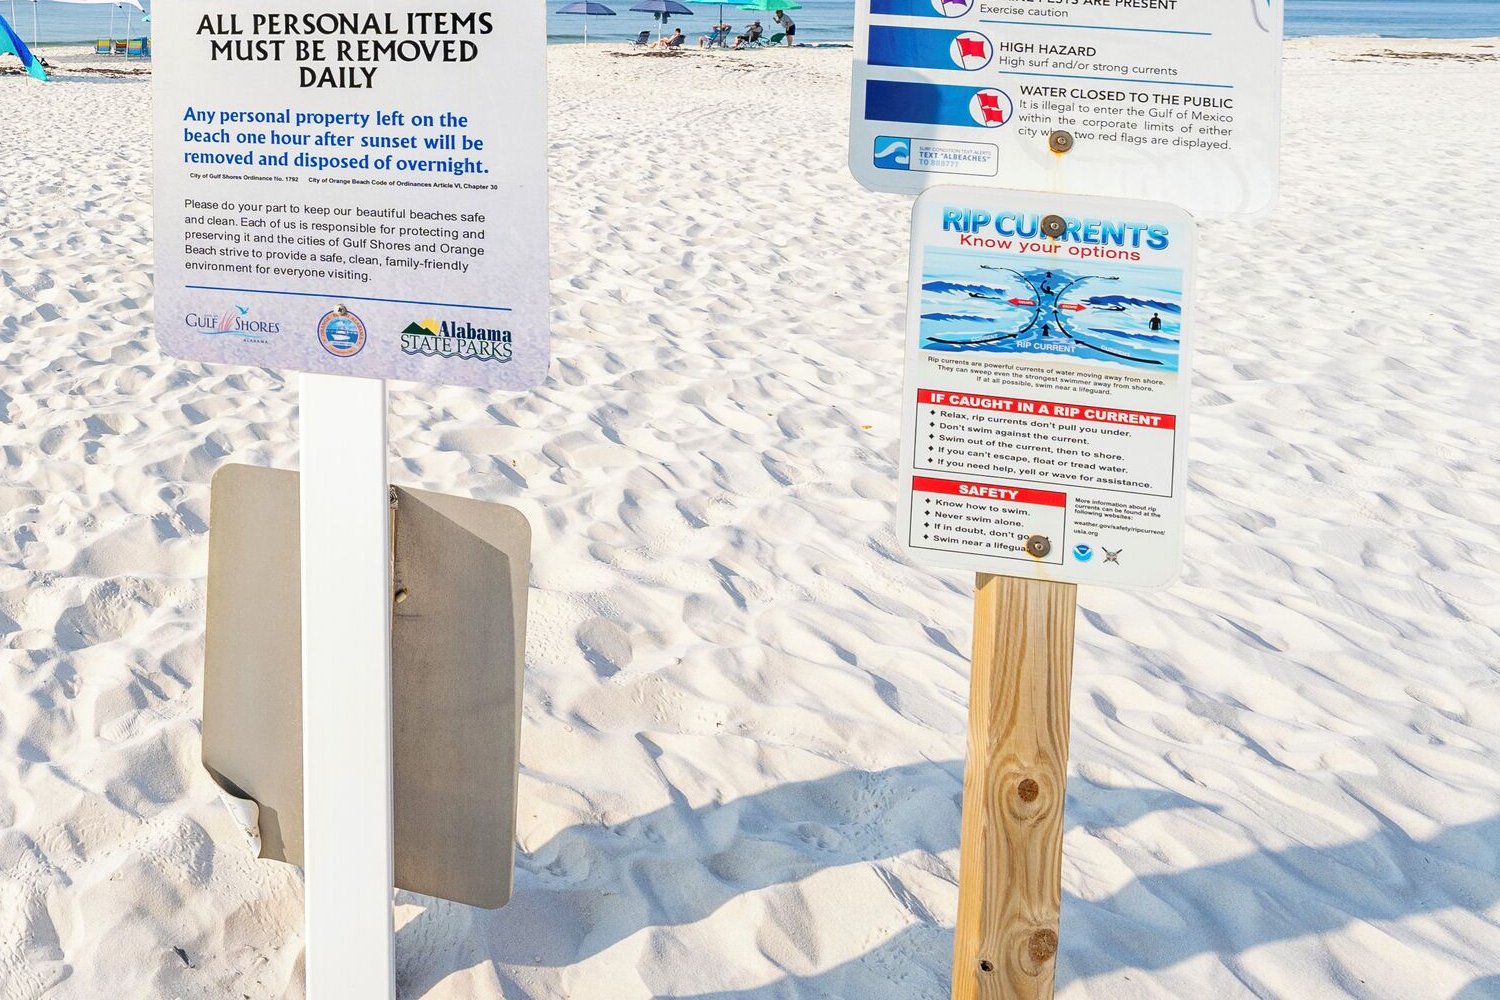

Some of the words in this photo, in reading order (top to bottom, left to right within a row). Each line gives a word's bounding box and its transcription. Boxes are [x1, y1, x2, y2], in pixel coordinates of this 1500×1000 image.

[980, 3, 1025, 16] Exercise
[1028, 8, 1069, 18] caution
[196, 14, 244, 35] ALL
[253, 12, 399, 35] PERSONAL
[407, 12, 493, 35] ITEMS
[210, 40, 286, 61] MUST
[295, 40, 326, 62] BE
[337, 40, 478, 62] REMOVED
[1000, 42, 1034, 54] HIGH
[1039, 44, 1097, 57] HAZARD
[300, 66, 378, 89] DAILY
[999, 56, 1025, 69] High
[1028, 58, 1050, 68] surf
[1052, 59, 1090, 70] and/or
[1092, 63, 1129, 76] strong
[1132, 66, 1178, 76] currents
[1020, 85, 1067, 98] WATER
[1070, 88, 1126, 102] CLOSED
[1129, 92, 1149, 104] TO
[1152, 94, 1180, 106] THE
[1184, 96, 1233, 109] PUBLIC
[183, 106, 216, 125] Any
[220, 108, 290, 125] personal
[296, 112, 370, 129] property
[376, 110, 405, 126] left
[411, 115, 434, 127] on
[439, 112, 468, 128] the
[1018, 113, 1052, 123] within
[1058, 115, 1076, 126] the
[1082, 119, 1138, 130] corporate
[1144, 120, 1175, 133] limits
[1180, 123, 1194, 134] of
[1198, 125, 1233, 136] either
[184, 128, 230, 143] beach
[236, 133, 266, 144] one
[271, 130, 311, 146] hour
[314, 131, 355, 147] after
[361, 136, 418, 149] sunset
[423, 134, 456, 150] will
[462, 135, 484, 151] be
[1018, 127, 1038, 139] city
[1074, 132, 1095, 140] two
[1098, 132, 1118, 142] red
[1120, 132, 1148, 146] flags
[1150, 137, 1169, 146] are
[1172, 136, 1232, 151] displayed.
[184, 150, 254, 165] removed
[258, 152, 288, 167] and
[294, 152, 369, 171] disposed
[374, 154, 393, 170] of
[396, 157, 489, 176] overnight.
[189, 172, 201, 180] City
[243, 174, 273, 182] Ordinance
[184, 198, 219, 210] Please
[221, 201, 235, 211] do
[238, 203, 264, 213] your
[266, 204, 287, 214] part
[289, 204, 300, 214] to
[304, 204, 331, 217] keep
[333, 207, 352, 216] our
[356, 206, 406, 219] beautiful
[410, 209, 458, 222] beaches
[460, 212, 486, 223] safe
[184, 215, 205, 225] and
[207, 216, 238, 227] clean.
[240, 217, 267, 228] Each
[269, 218, 281, 229] of
[283, 221, 297, 230] us
[299, 220, 309, 230] is
[311, 222, 376, 234] responsible
[380, 224, 396, 235] for
[399, 226, 459, 241] protecting
[462, 229, 485, 240] and
[942, 206, 991, 235] RIP
[995, 211, 1170, 250] CURENTS
[960, 234, 1012, 250] Know
[1019, 242, 1062, 254] your
[1068, 246, 1141, 261] options
[185, 260, 253, 274] environment
[255, 264, 271, 274] for
[273, 267, 326, 279] everyone
[327, 269, 372, 283] visiting.
[186, 313, 218, 329] GULF
[236, 317, 280, 334] SHORES
[438, 320, 512, 343] Alabama
[400, 334, 452, 353] STATE
[457, 339, 513, 358] PARKS
[1016, 341, 1032, 349] RIP
[1034, 342, 1077, 353] CURRENT
[931, 393, 945, 403] IF
[950, 396, 1013, 411] CAUGHT
[1017, 402, 1034, 413] IN
[1038, 404, 1050, 415] A
[1054, 406, 1080, 417] RIP
[1084, 410, 1162, 427] CURRENT
[939, 422, 965, 432] Don't
[967, 426, 993, 434] swim
[995, 429, 1031, 439] against
[1033, 433, 1049, 441] the
[1051, 436, 1090, 445] current.
[940, 410, 969, 421] Relax,
[972, 414, 985, 423] rip
[987, 417, 1028, 426] currents
[1030, 420, 1056, 429] don't
[1079, 426, 1098, 434] you
[1100, 429, 1132, 437] under.
[959, 484, 1019, 500] SAFETY
[935, 499, 964, 508] Know
[966, 502, 987, 511] how
[989, 505, 1000, 513] to
[1002, 508, 1030, 516] swim.
[934, 511, 964, 520] Never
[966, 516, 992, 524] swim
[994, 518, 1024, 528] alone.
